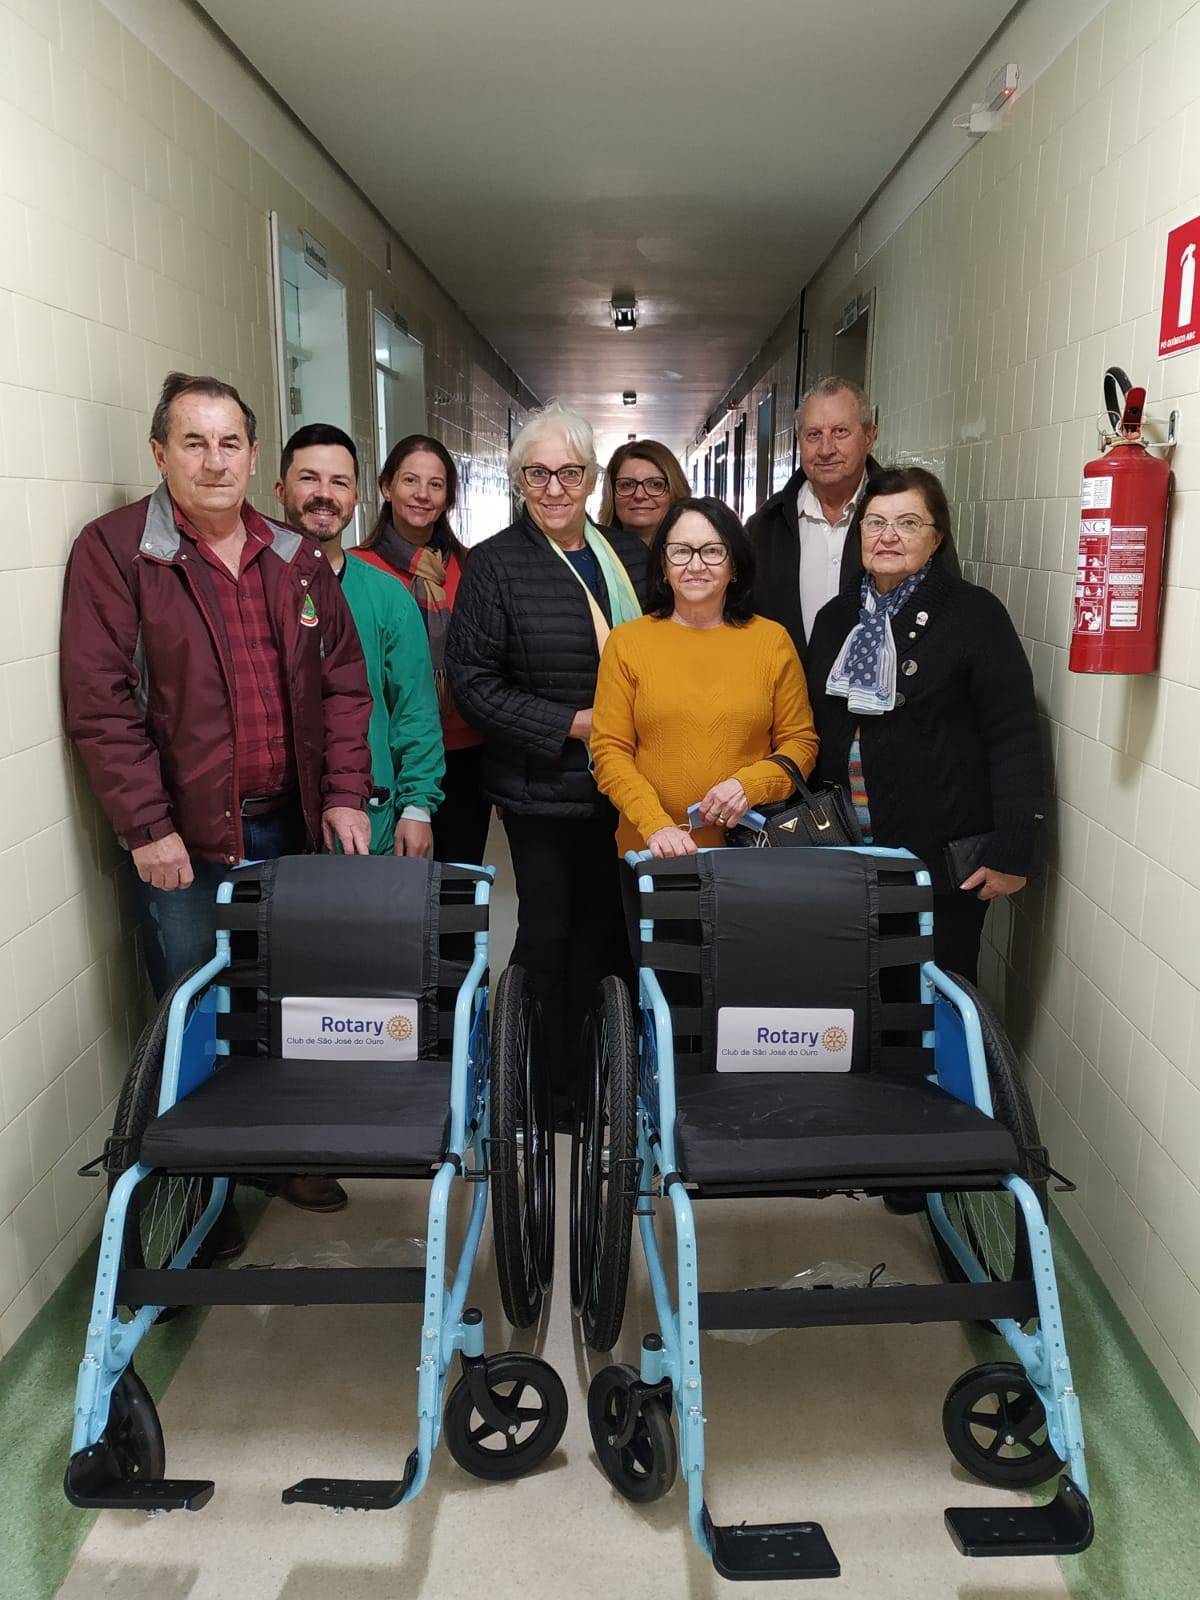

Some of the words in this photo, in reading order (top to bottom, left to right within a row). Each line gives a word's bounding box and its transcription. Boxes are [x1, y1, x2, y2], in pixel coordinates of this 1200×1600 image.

[322, 1016, 384, 1036] Rotary
[286, 1036, 304, 1045] Club
[305, 1037, 316, 1045] de
[318, 1036, 332, 1046] São
[334, 1037, 352, 1046] José
[354, 1037, 364, 1045] do
[365, 1037, 385, 1046] Ouro
[757, 1027, 819, 1047] Rotary
[721, 1048, 739, 1056] Club
[740, 1048, 750, 1056] de
[752, 1047, 767, 1056] São
[769, 1048, 787, 1056] José
[788, 1048, 798, 1056] do
[800, 1048, 819, 1056] Ouro
